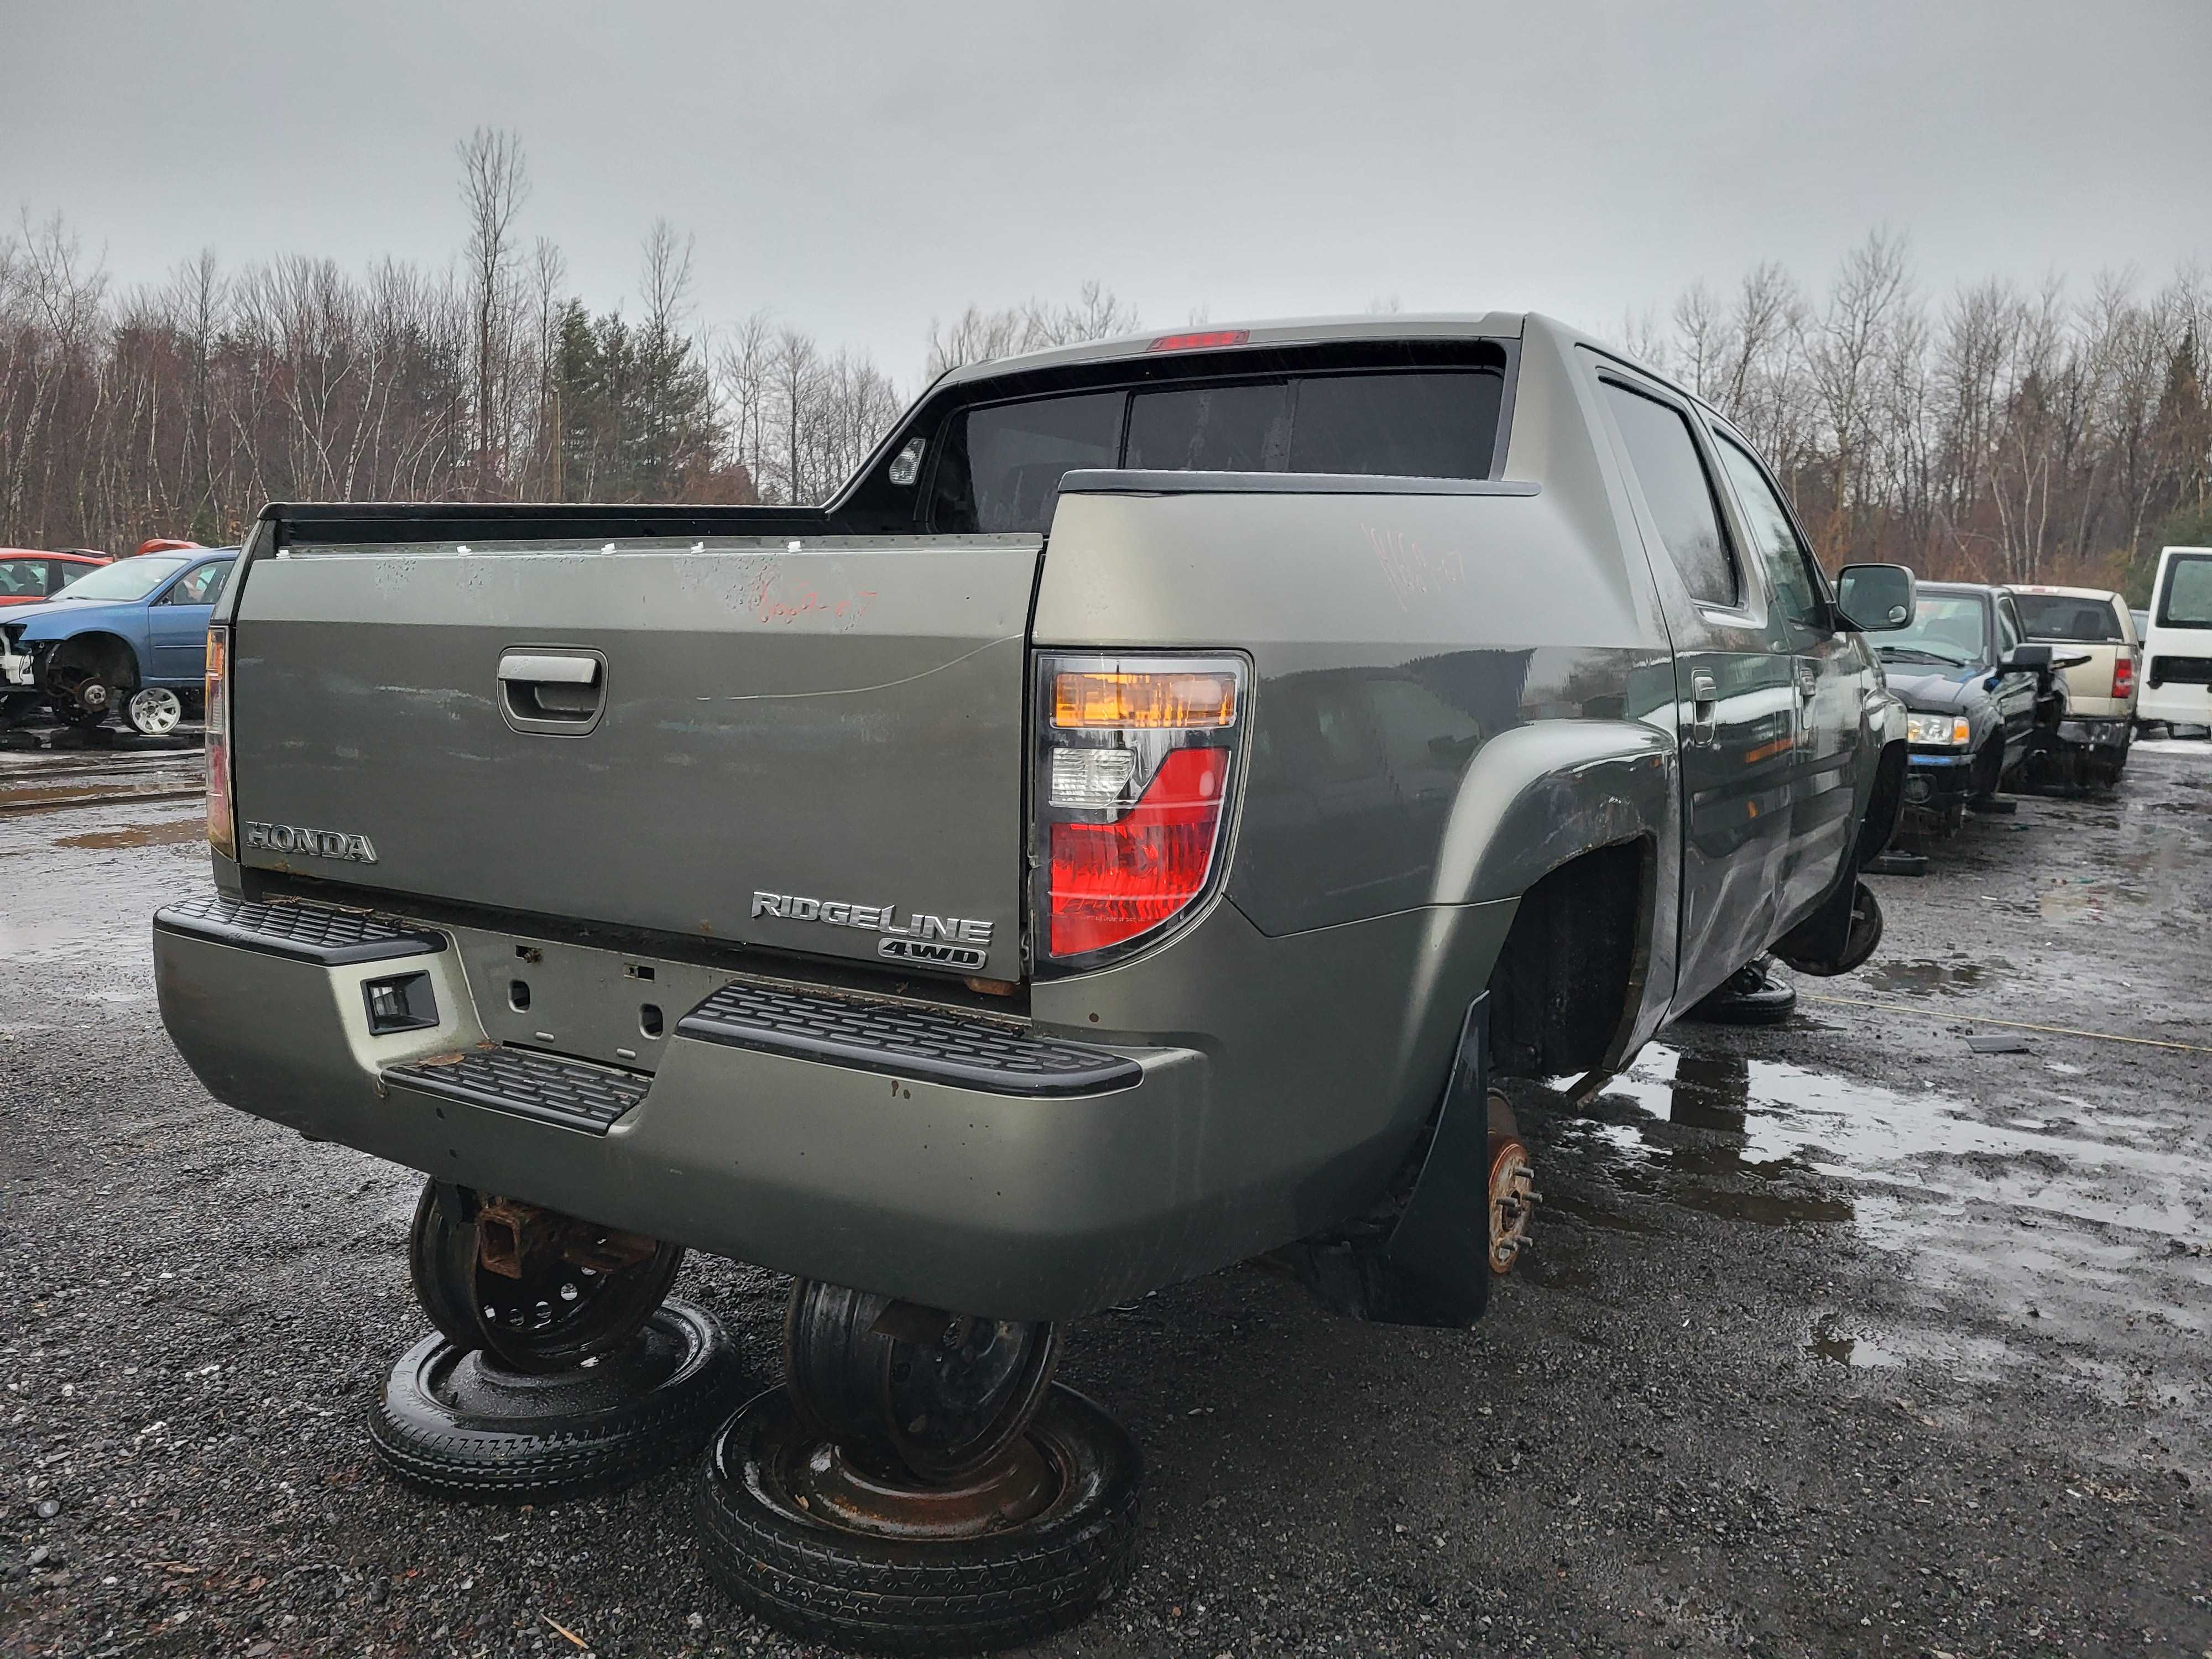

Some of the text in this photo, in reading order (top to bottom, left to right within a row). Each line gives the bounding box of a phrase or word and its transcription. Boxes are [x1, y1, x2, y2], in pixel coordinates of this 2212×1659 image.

[245, 821, 380, 864] HONDA
[750, 890, 995, 946] RIDGELINE
[881, 940, 981, 967] 4WD
